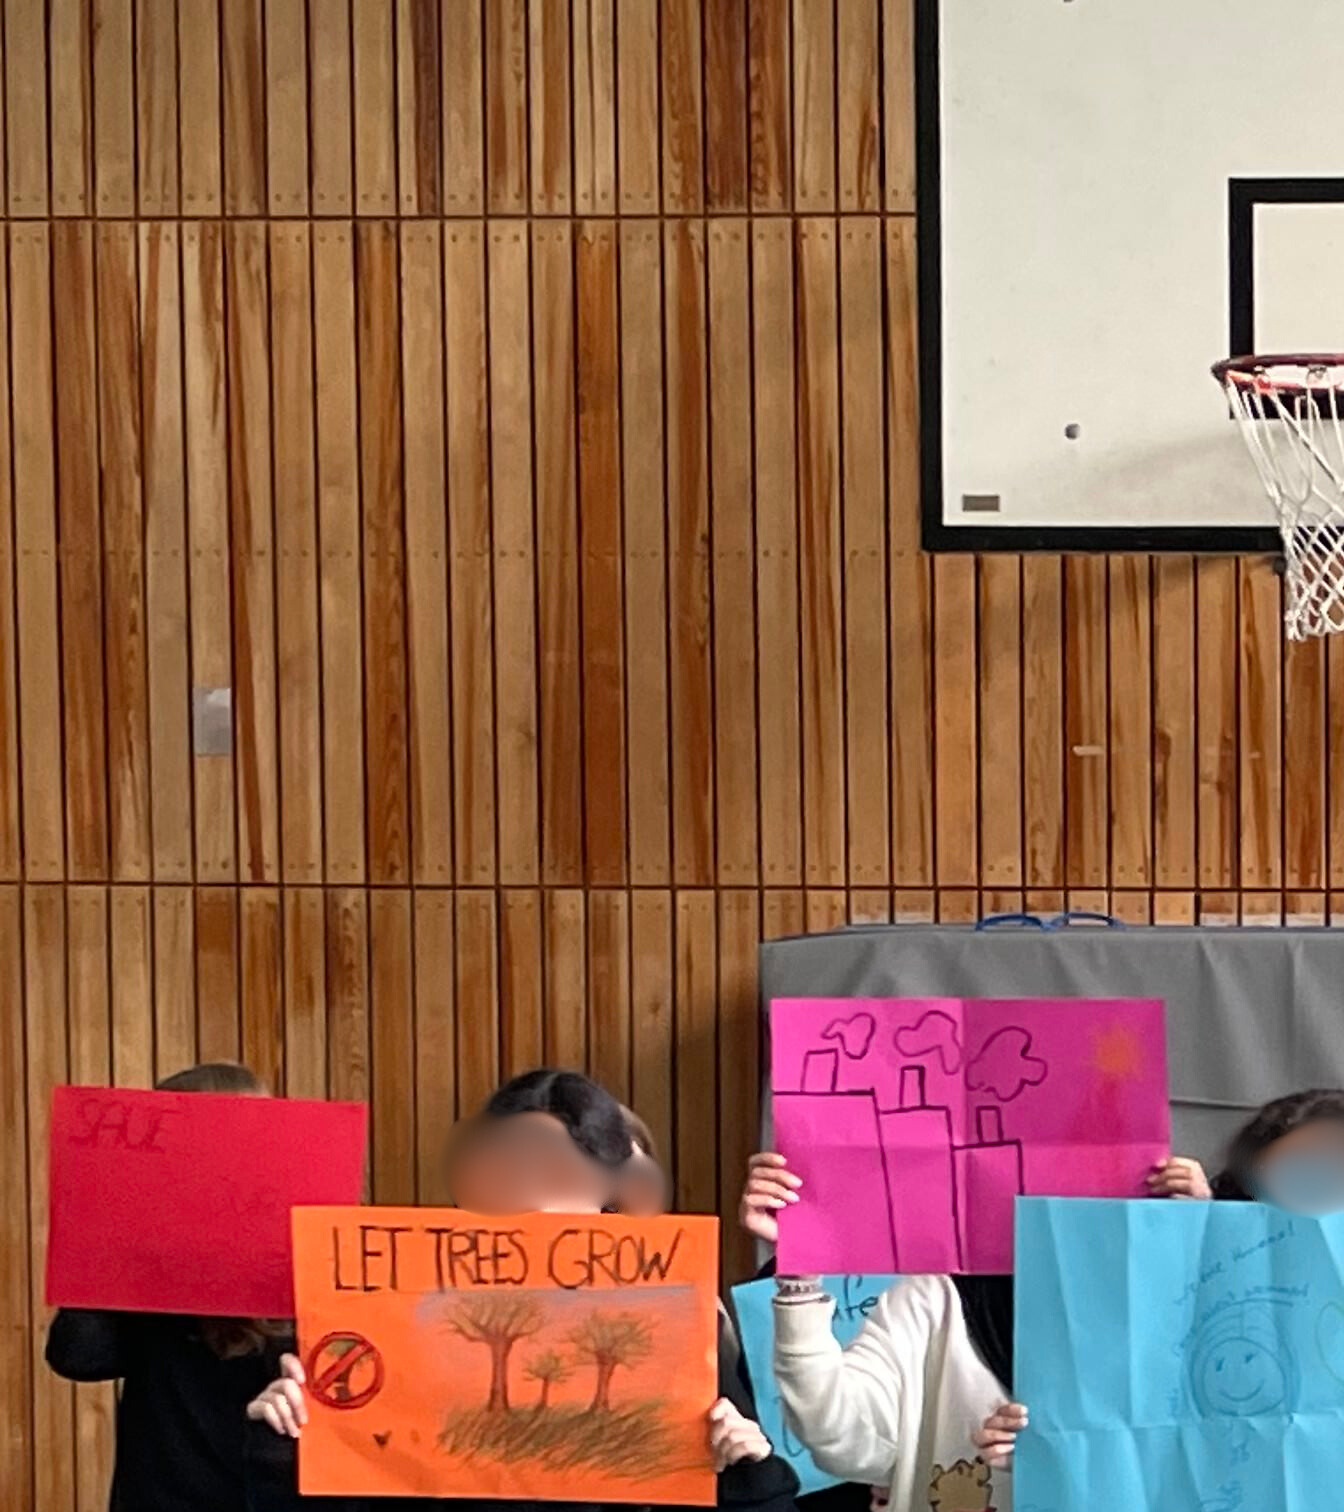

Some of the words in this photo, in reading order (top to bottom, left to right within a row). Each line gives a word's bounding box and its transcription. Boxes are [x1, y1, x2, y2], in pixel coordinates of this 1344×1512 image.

[332, 1224, 414, 1293] LET
[424, 1226, 531, 1294] TREES
[546, 1226, 685, 1291] GROW
